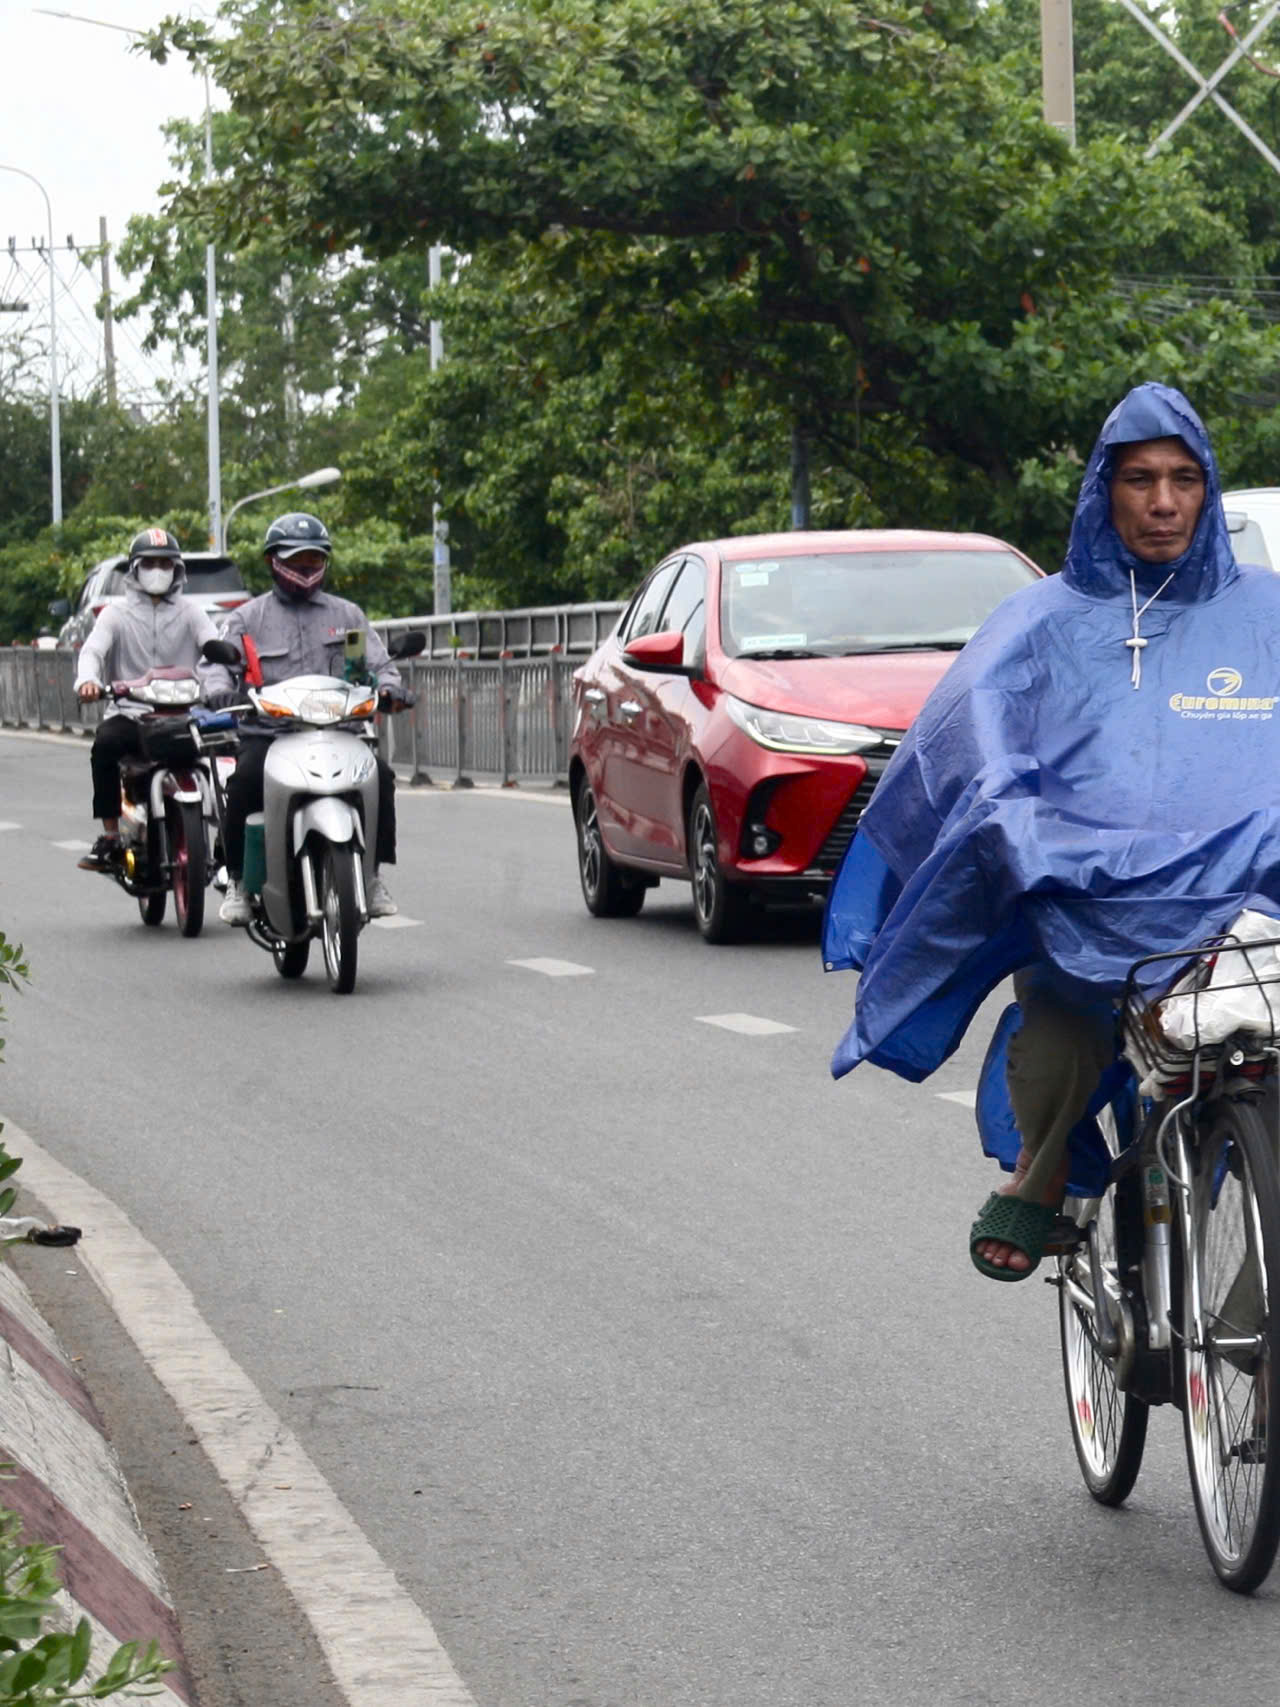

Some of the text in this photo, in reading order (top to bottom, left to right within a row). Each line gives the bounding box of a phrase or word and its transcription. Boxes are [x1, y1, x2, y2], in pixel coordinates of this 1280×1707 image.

[1169, 693, 1275, 711] Euromina
[1217, 711, 1231, 721] gia
[1260, 712, 1273, 721] ga
